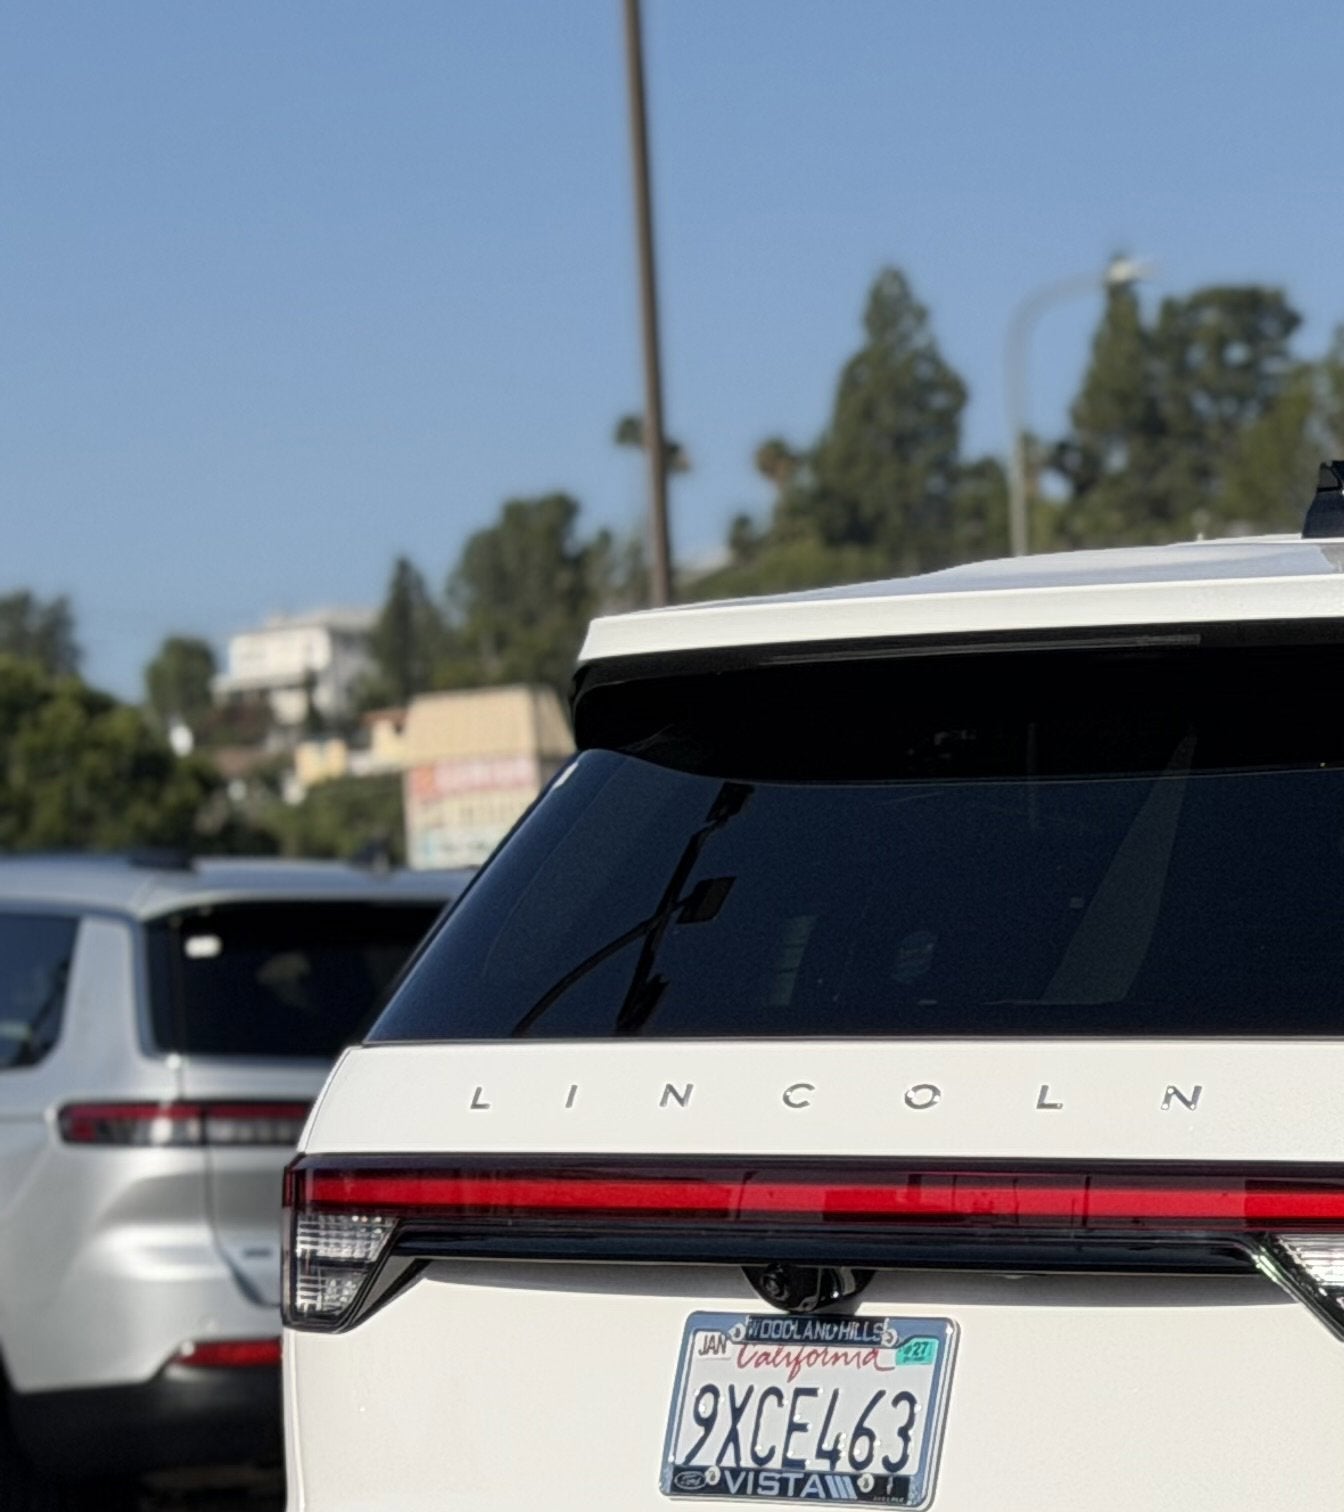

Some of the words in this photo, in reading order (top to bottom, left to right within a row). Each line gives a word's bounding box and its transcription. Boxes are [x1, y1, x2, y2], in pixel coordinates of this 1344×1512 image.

[470, 1082, 1202, 1112] LINCOLN
[699, 1333, 727, 1356] JAN
[748, 1318, 838, 1342] WOODLAND
[838, 1321, 885, 1343] HILLS
[736, 1343, 895, 1383] California
[682, 1383, 918, 1473] 9XCE463
[724, 1470, 826, 1499] VISTA
